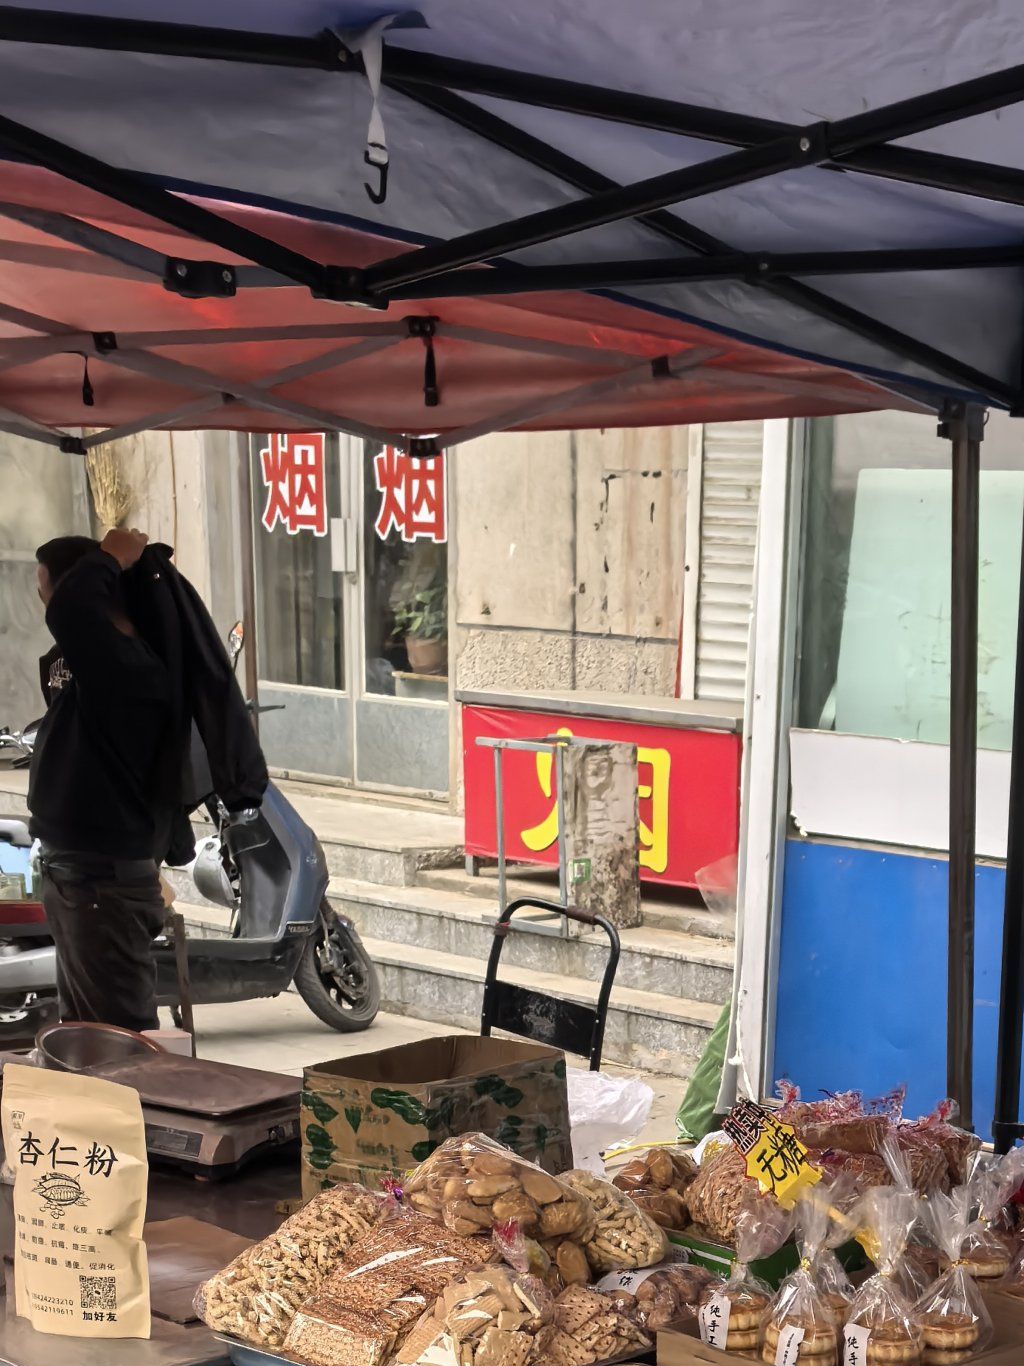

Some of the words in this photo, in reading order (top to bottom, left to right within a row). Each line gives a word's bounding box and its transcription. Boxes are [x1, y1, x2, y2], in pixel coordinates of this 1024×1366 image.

[261, 433, 328, 537] 烟
[374, 444, 447, 543] 烟
[18, 1131, 118, 1177] 杏仁粉
[757, 1123, 805, 1191] 无糖
[82, 1310, 118, 1322] 加好友
